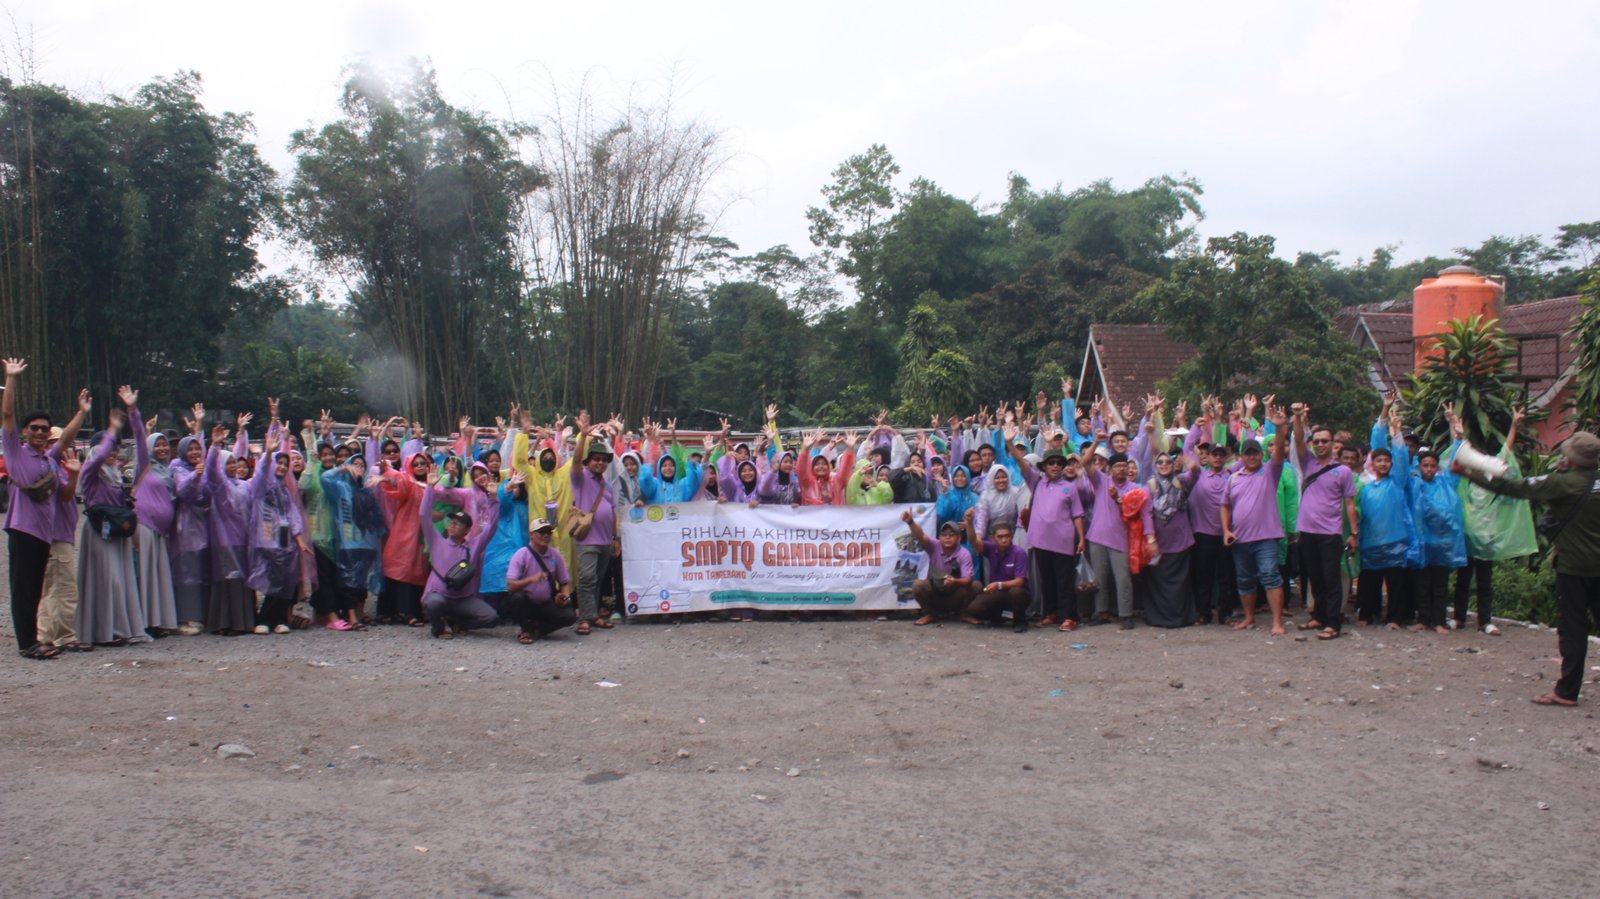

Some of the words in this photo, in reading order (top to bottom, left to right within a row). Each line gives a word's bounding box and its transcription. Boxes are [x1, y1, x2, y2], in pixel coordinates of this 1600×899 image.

[681, 526, 746, 539] RIHLAH
[752, 527, 881, 540] AKHIRUSANAH
[681, 540, 755, 571] SMPTQ
[762, 542, 881, 567] GANDASARI
[682, 571, 703, 581] KOTA
